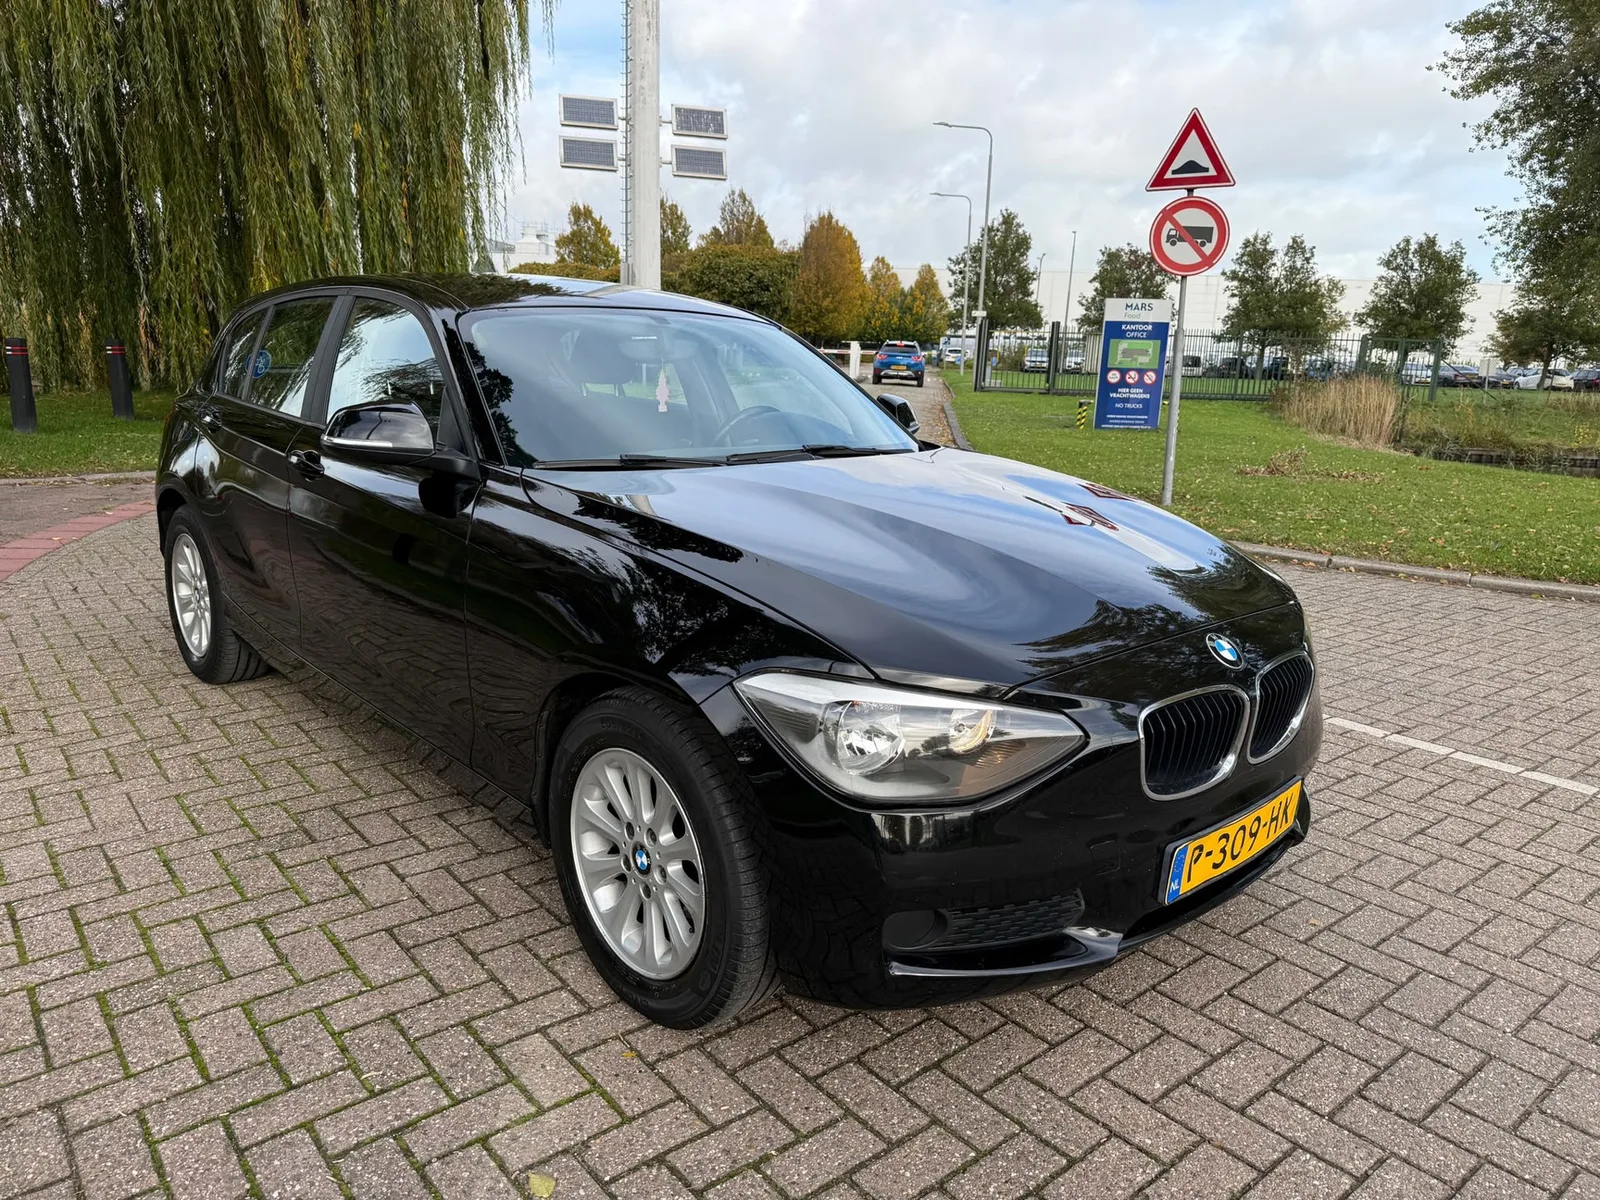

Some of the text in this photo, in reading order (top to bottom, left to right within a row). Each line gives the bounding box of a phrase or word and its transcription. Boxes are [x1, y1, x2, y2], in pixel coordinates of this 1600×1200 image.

[1125, 302, 1153, 311] MARS
[1186, 792, 1295, 884] P-309-HK
[1169, 878, 1180, 893] NL
